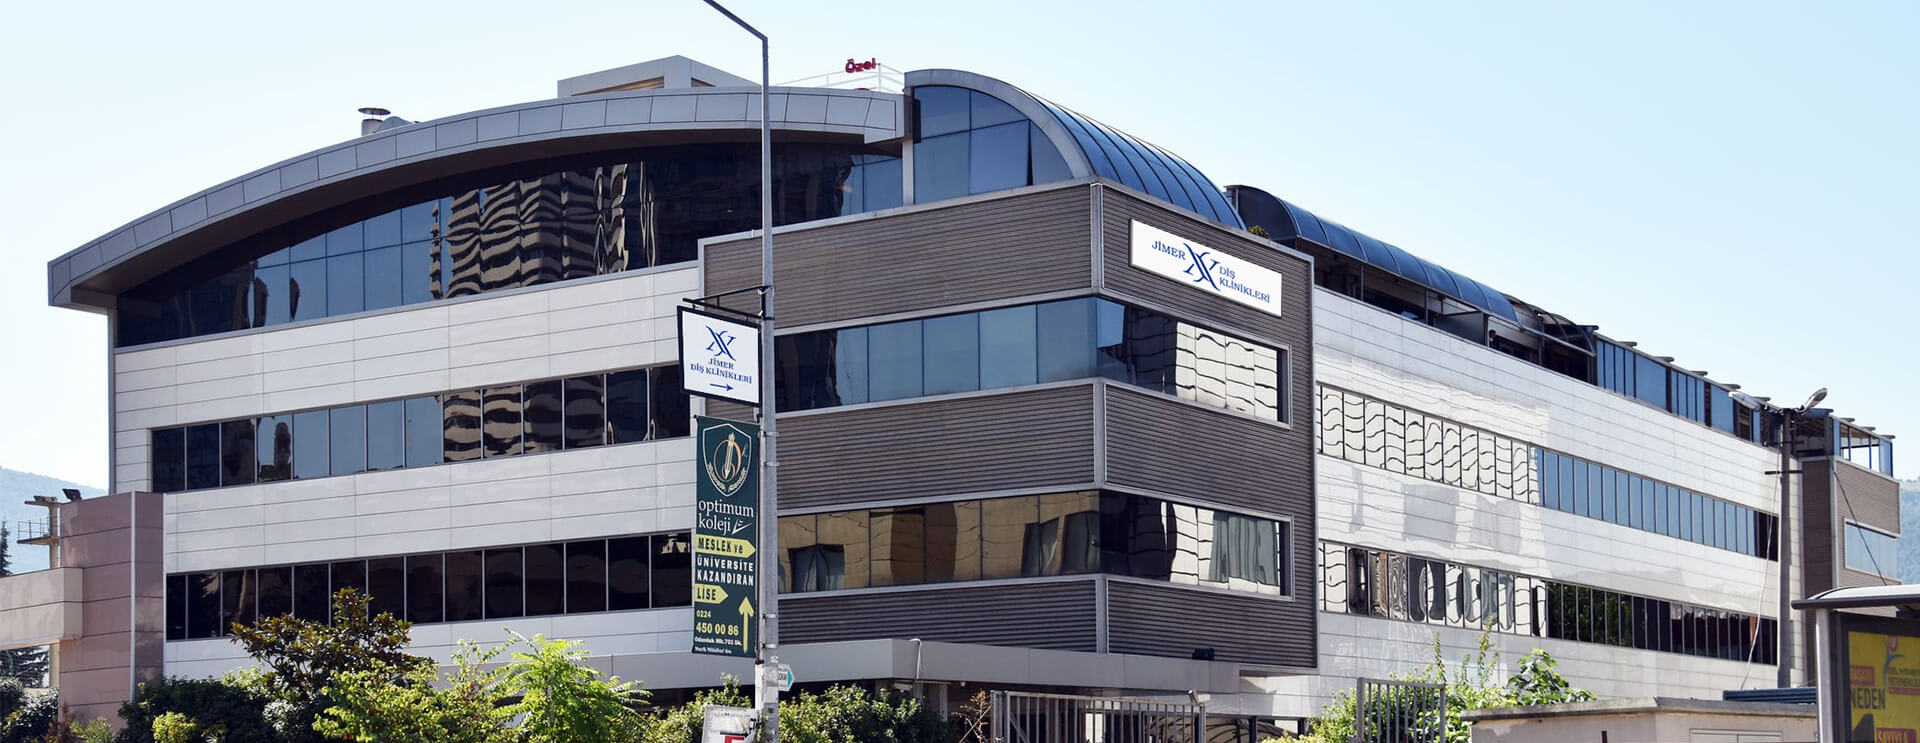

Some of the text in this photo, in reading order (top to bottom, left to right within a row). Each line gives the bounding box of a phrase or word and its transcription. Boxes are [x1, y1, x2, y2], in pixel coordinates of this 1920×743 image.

[845, 58, 876, 73] Özel
[1151, 240, 1186, 260] JİMER
[1219, 266, 1236, 279] DİŞ
[1219, 277, 1270, 303] KLİNİKLERİ
[708, 358, 734, 369] JİMER
[690, 363, 752, 384] DİŞ KLİNİKLERİ
[698, 499, 754, 517] optimum
[698, 513, 731, 536] koleji
[698, 537, 732, 553] MESLEK
[697, 554, 754, 572] ÜNİVERSİTE
[697, 569, 754, 586] KAZANDIRAN
[697, 585, 717, 600] LİSE
[696, 609, 712, 618] 0224
[696, 622, 740, 636] 450 00 86
